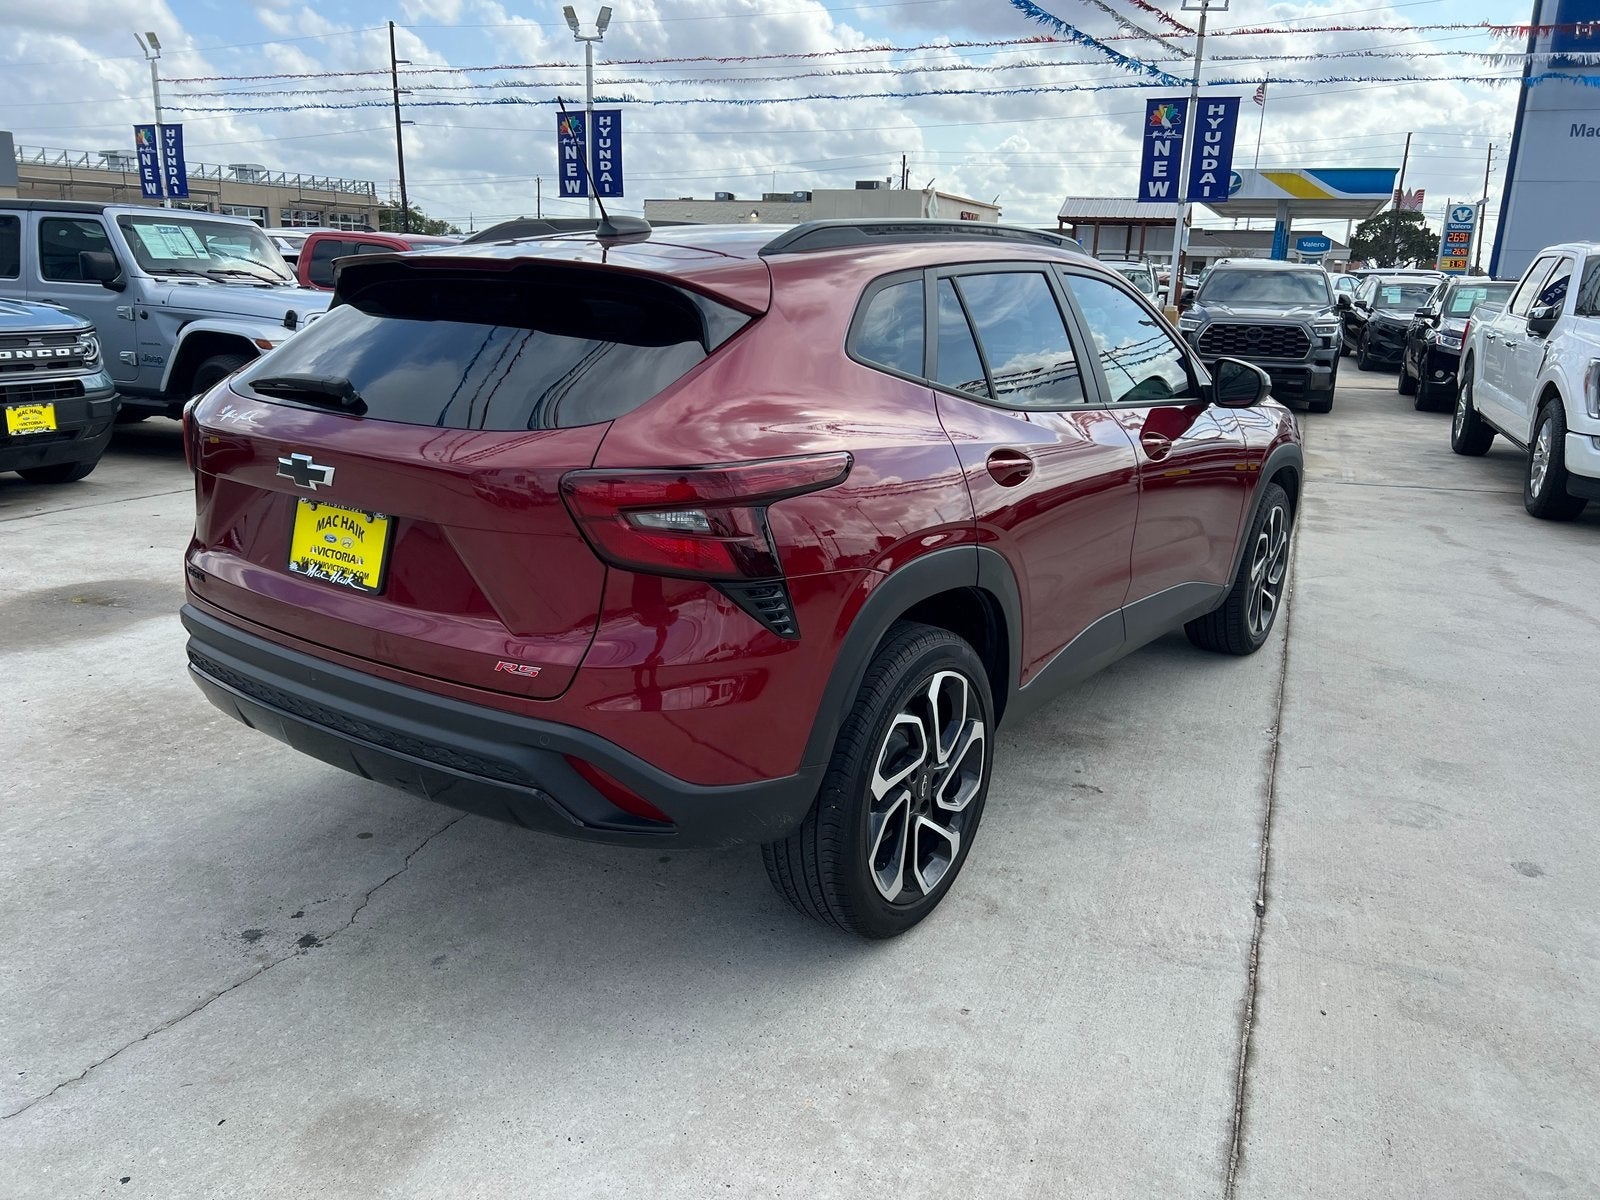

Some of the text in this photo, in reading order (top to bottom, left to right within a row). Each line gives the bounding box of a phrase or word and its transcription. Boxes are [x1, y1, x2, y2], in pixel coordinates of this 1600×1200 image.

[165, 129, 180, 194] HYUNDAI
[564, 146, 581, 194] NEW
[599, 116, 613, 193] HYUNDAI
[1148, 140, 1171, 197] NEW
[1199, 104, 1225, 197] HYUNDAI
[141, 153, 157, 194] NEW
[316, 514, 340, 532] MAC
[340, 515, 365, 543] HAIK
[306, 563, 328, 580] Mac
[317, 545, 356, 564] VICTORIA
[494, 660, 542, 678] RS
